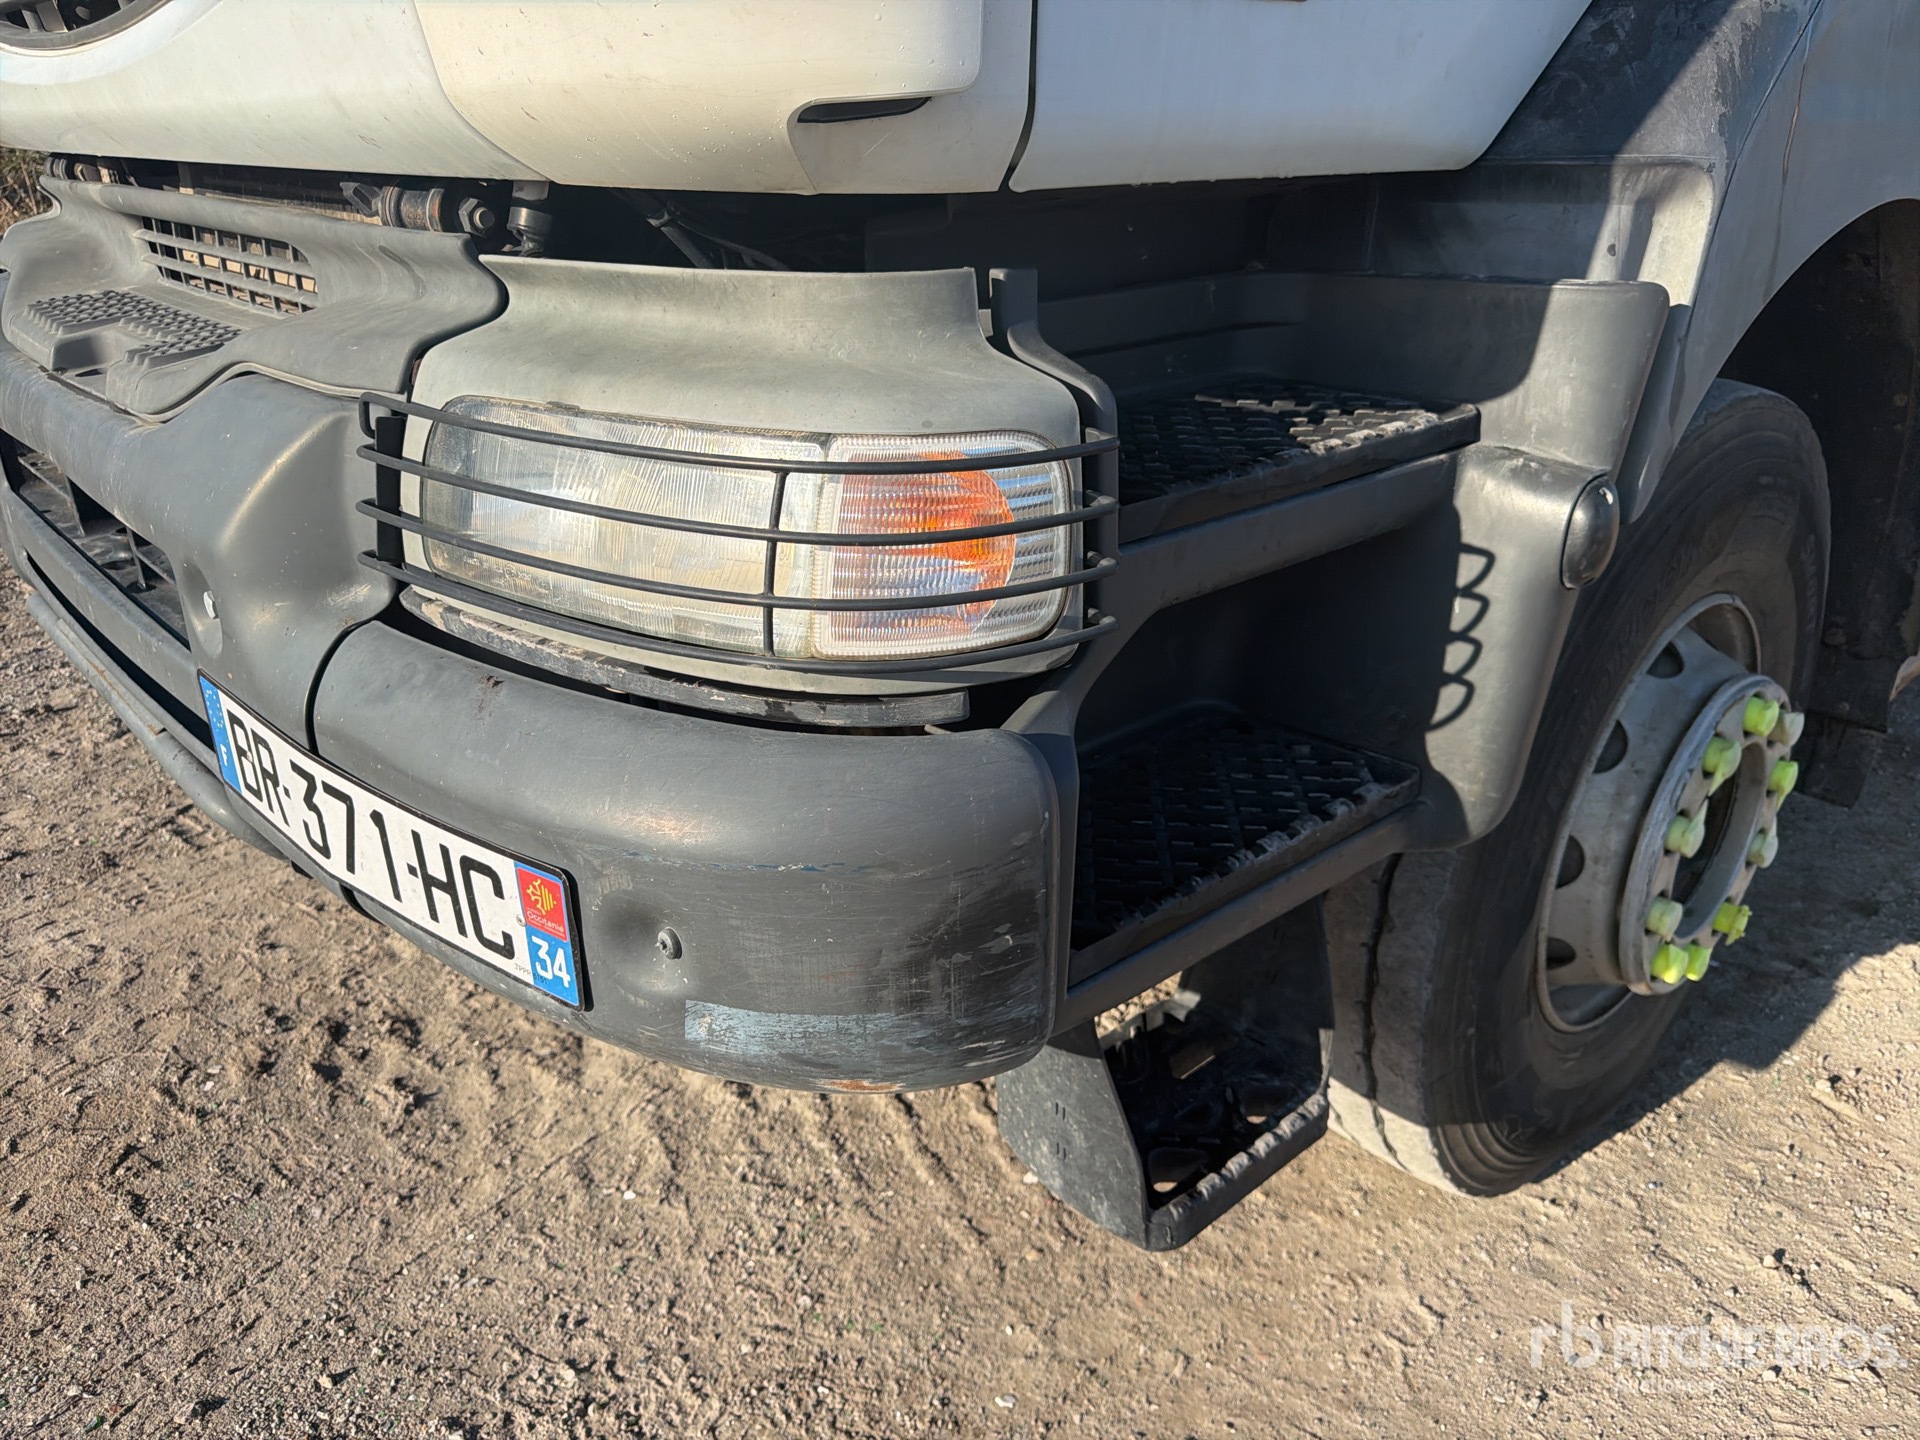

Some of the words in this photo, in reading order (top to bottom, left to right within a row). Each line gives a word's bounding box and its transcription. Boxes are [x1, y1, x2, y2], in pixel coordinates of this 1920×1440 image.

[220, 743, 228, 767] F
[226, 708, 516, 961] BR-371-HC
[526, 910, 565, 933] Occitanie
[531, 935, 571, 989] 34
